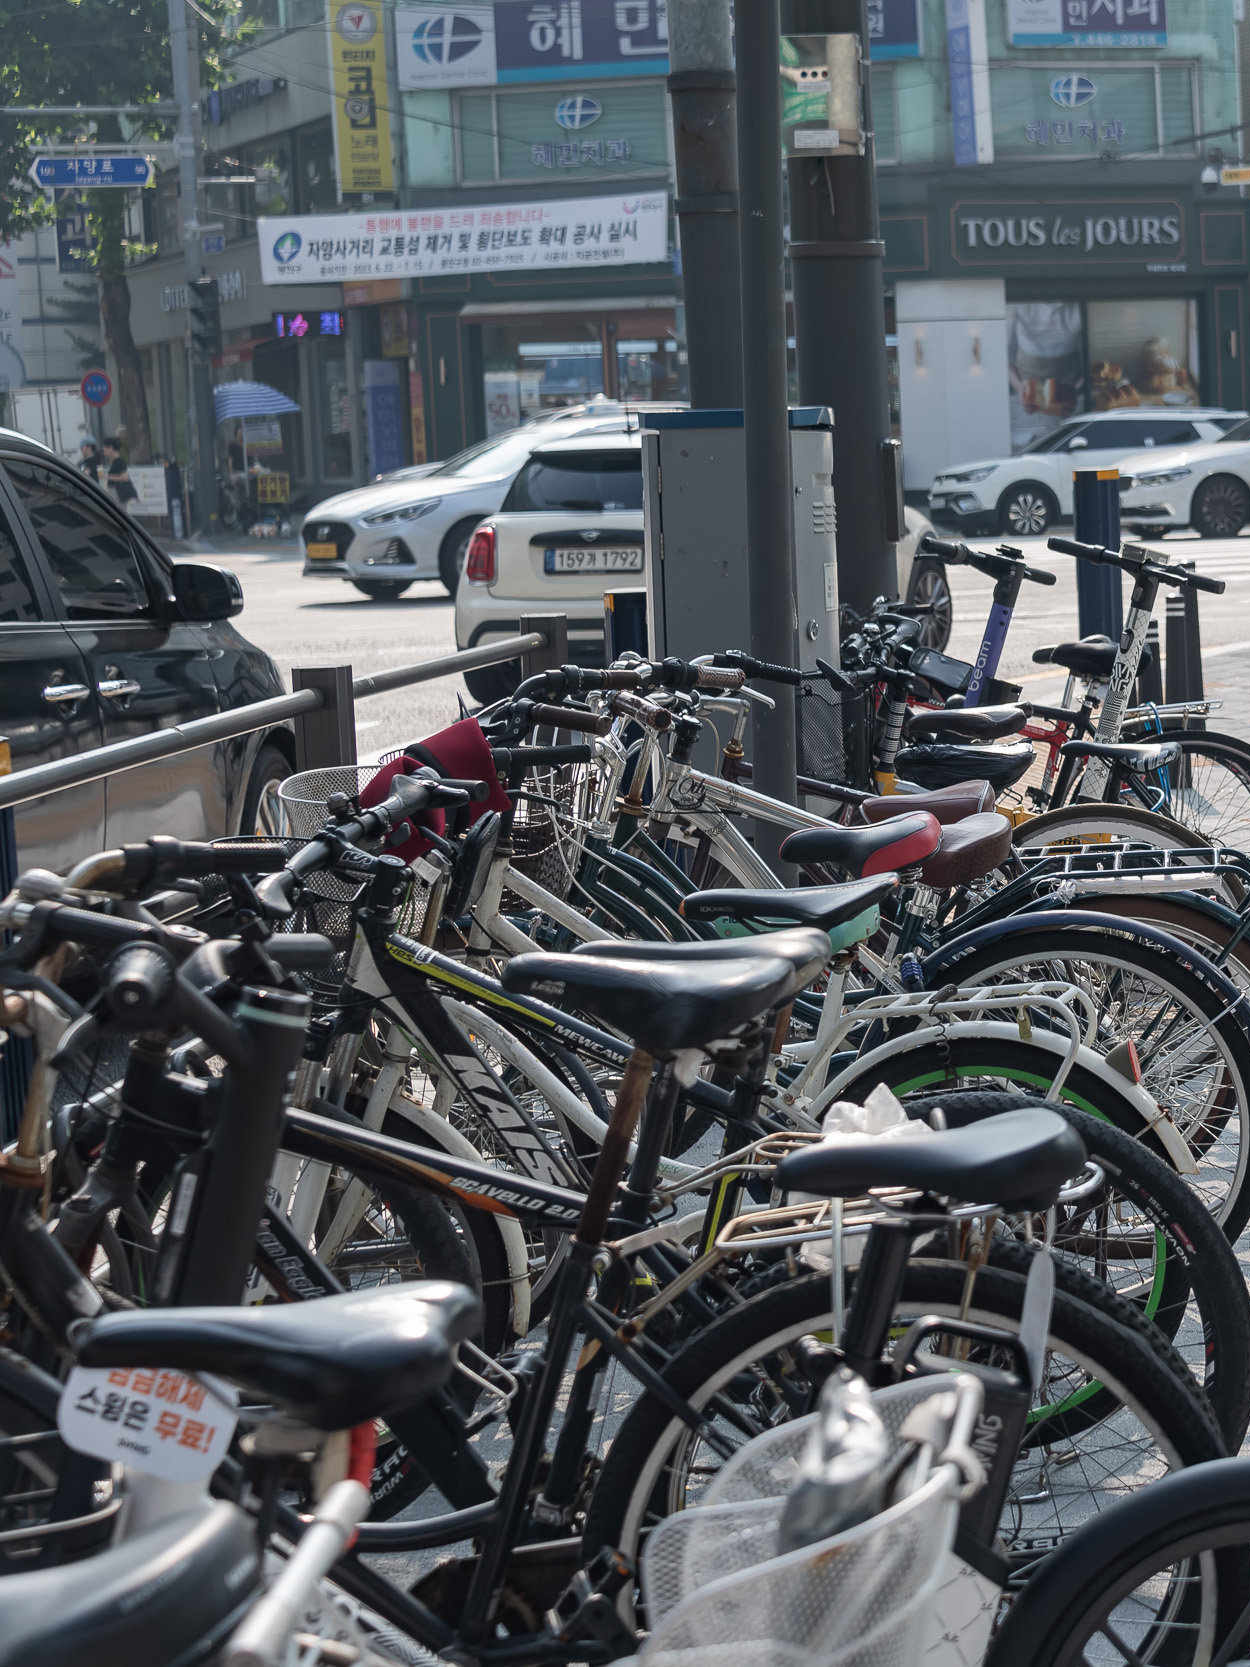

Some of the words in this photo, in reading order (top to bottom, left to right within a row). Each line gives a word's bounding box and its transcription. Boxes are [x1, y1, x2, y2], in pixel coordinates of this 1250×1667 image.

[1026, 119, 1125, 145] 혜민치과
[66, 159, 114, 175] 자양로
[530, 138, 630, 168] 혜민치과
[307, 236, 374, 262] 자양사거리
[379, 233, 421, 258] 교통섬
[425, 231, 453, 256] 제거
[458, 229, 471, 252] 및
[477, 227, 532, 251] 횡단보도
[538, 225, 568, 247] 확대
[573, 222, 603, 246] 공사
[607, 219, 638, 243] 실시
[959, 216, 1047, 247] TOUS
[1052, 215, 1082, 246] les
[1084, 214, 1181, 252] JOURS
[601, 549, 639, 569] 1792
[967, 640, 992, 692] beam
[880, 977, 899, 993] SMART
[543, 1205, 582, 1221] 2.0
[1144, 1206, 1191, 1267] NOVATEC
[74, 1386, 151, 1432] 스윙은
[154, 1410, 217, 1454] 무료!
